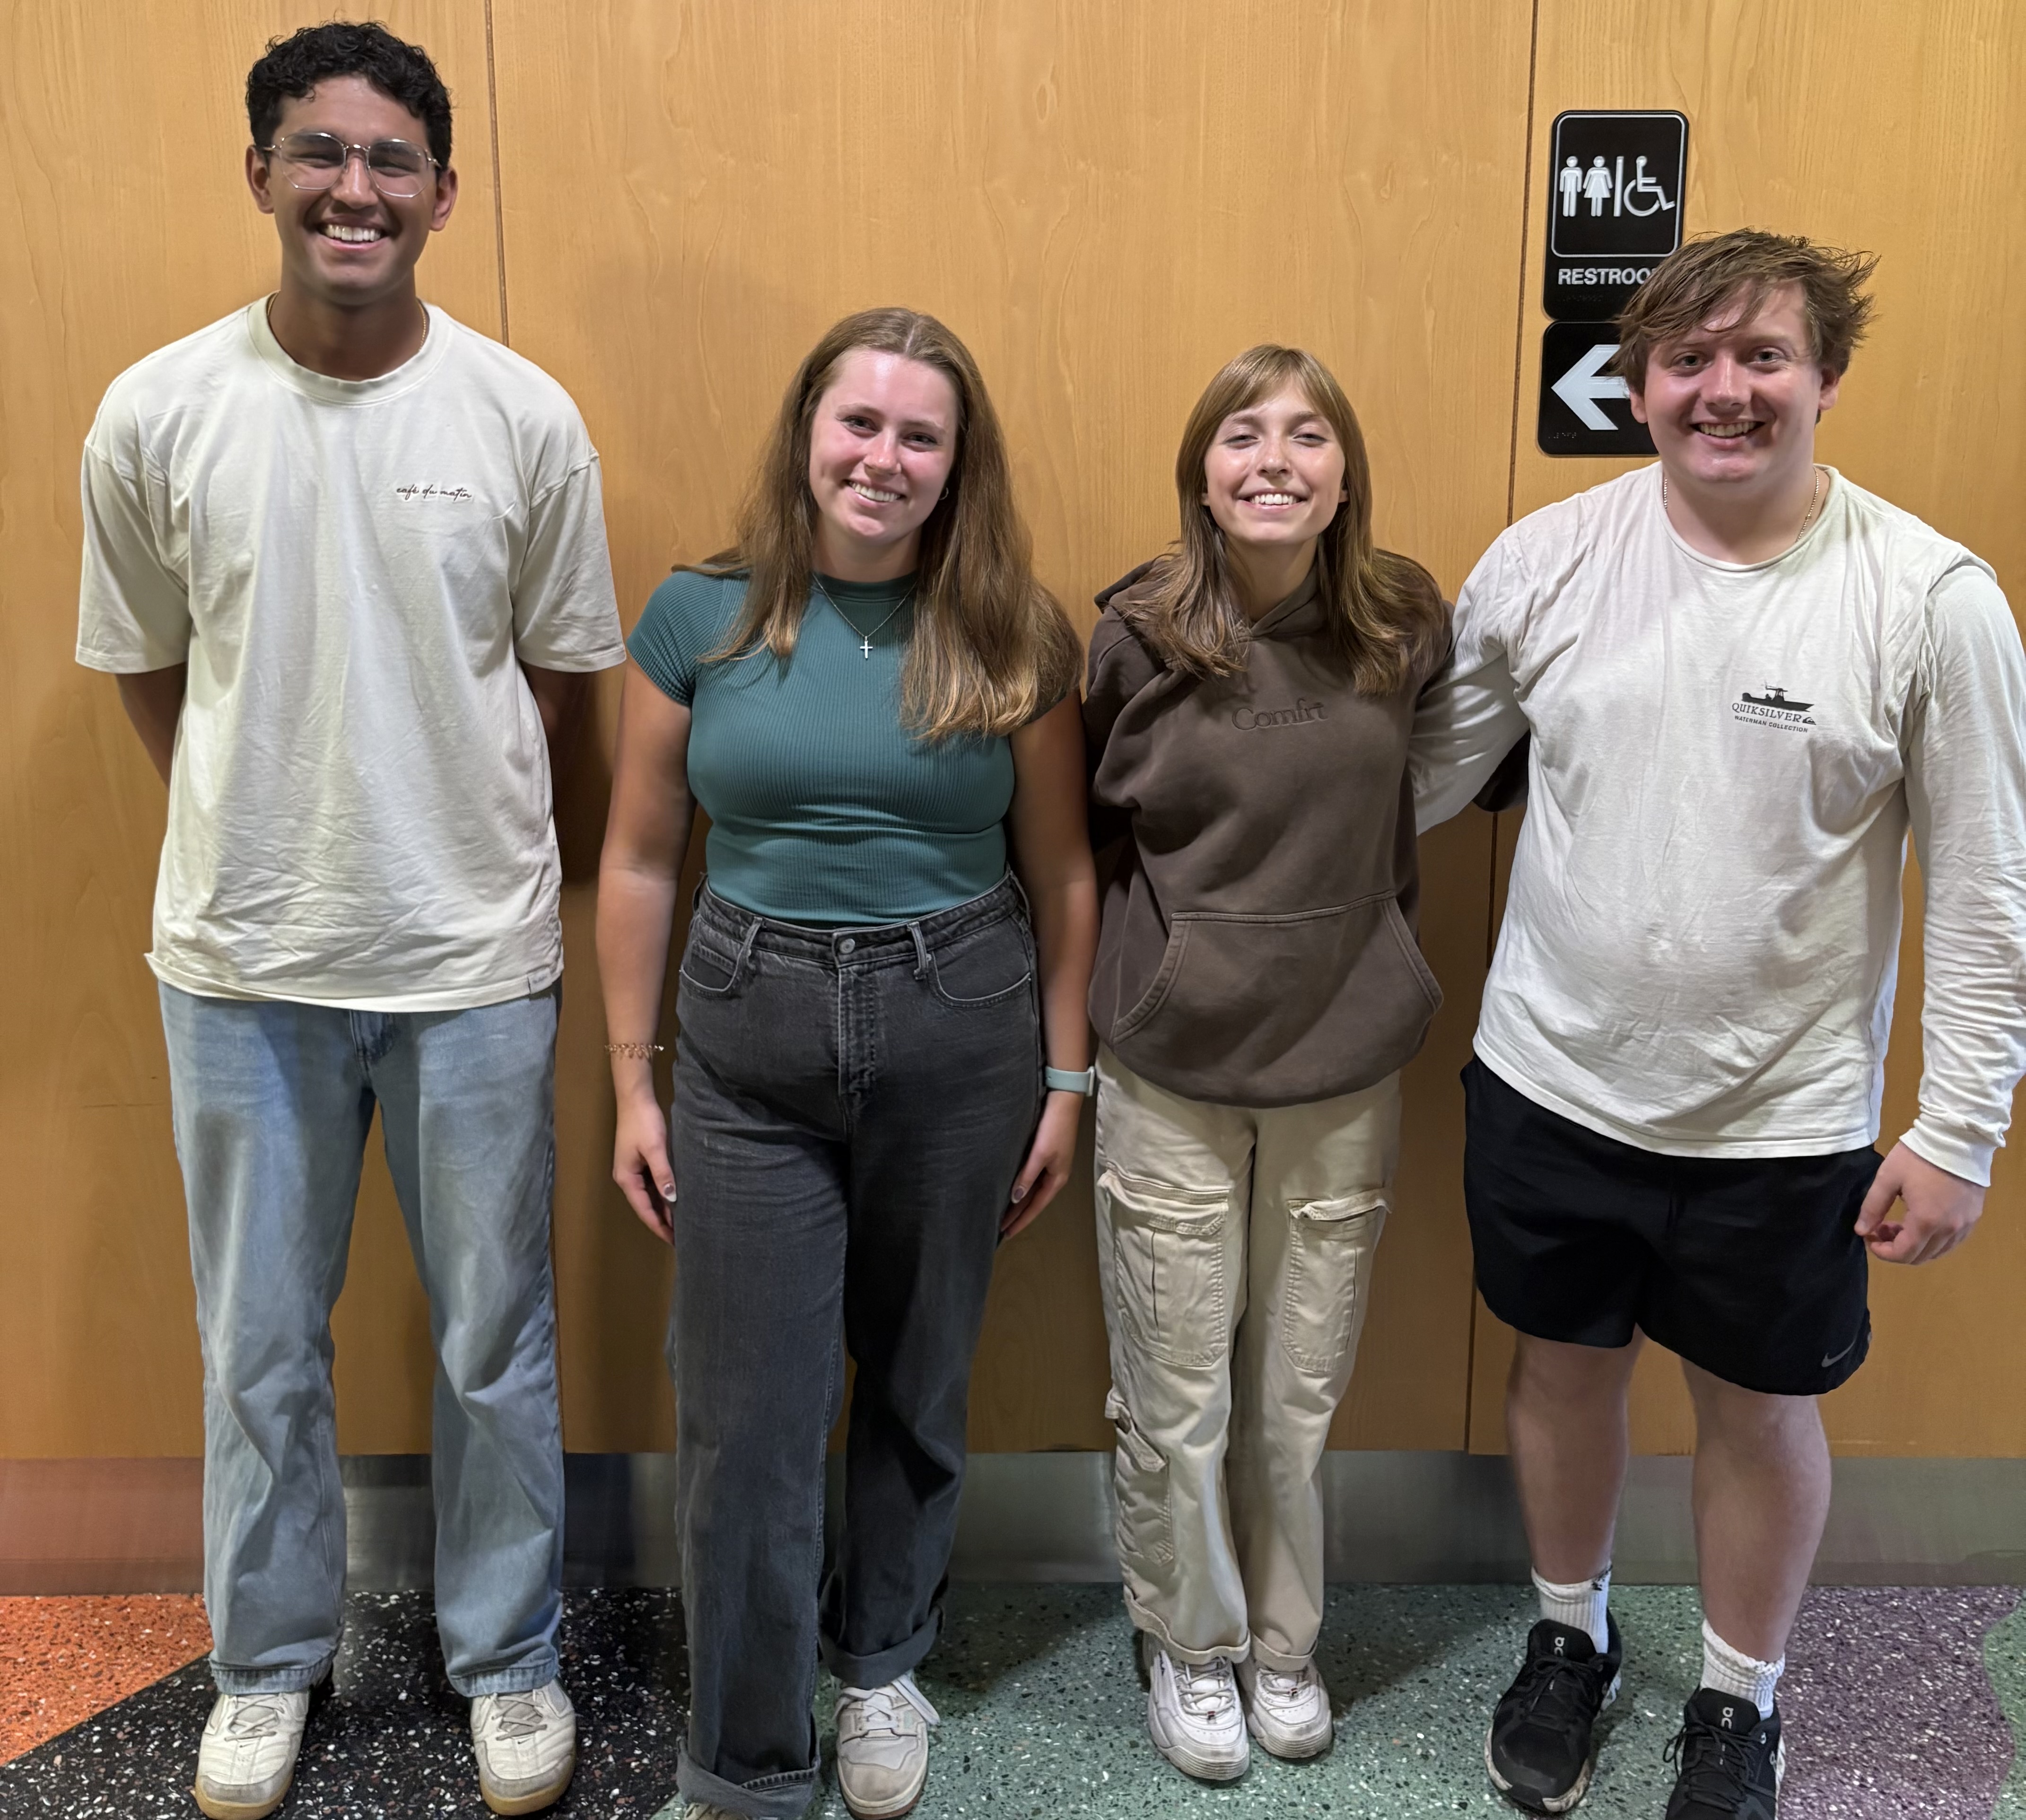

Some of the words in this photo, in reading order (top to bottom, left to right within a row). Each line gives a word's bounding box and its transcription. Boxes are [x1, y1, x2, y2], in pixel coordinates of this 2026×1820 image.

[1558, 268, 1657, 285] RESTROO
[422, 484, 437, 499] du
[439, 487, 472, 501] matin
[1231, 698, 1328, 730] Comfrt
[1732, 703, 1802, 723] QUIKSILVER
[1734, 715, 1767, 726] WATERMAN
[1768, 722, 1808, 733] COLLECTION
